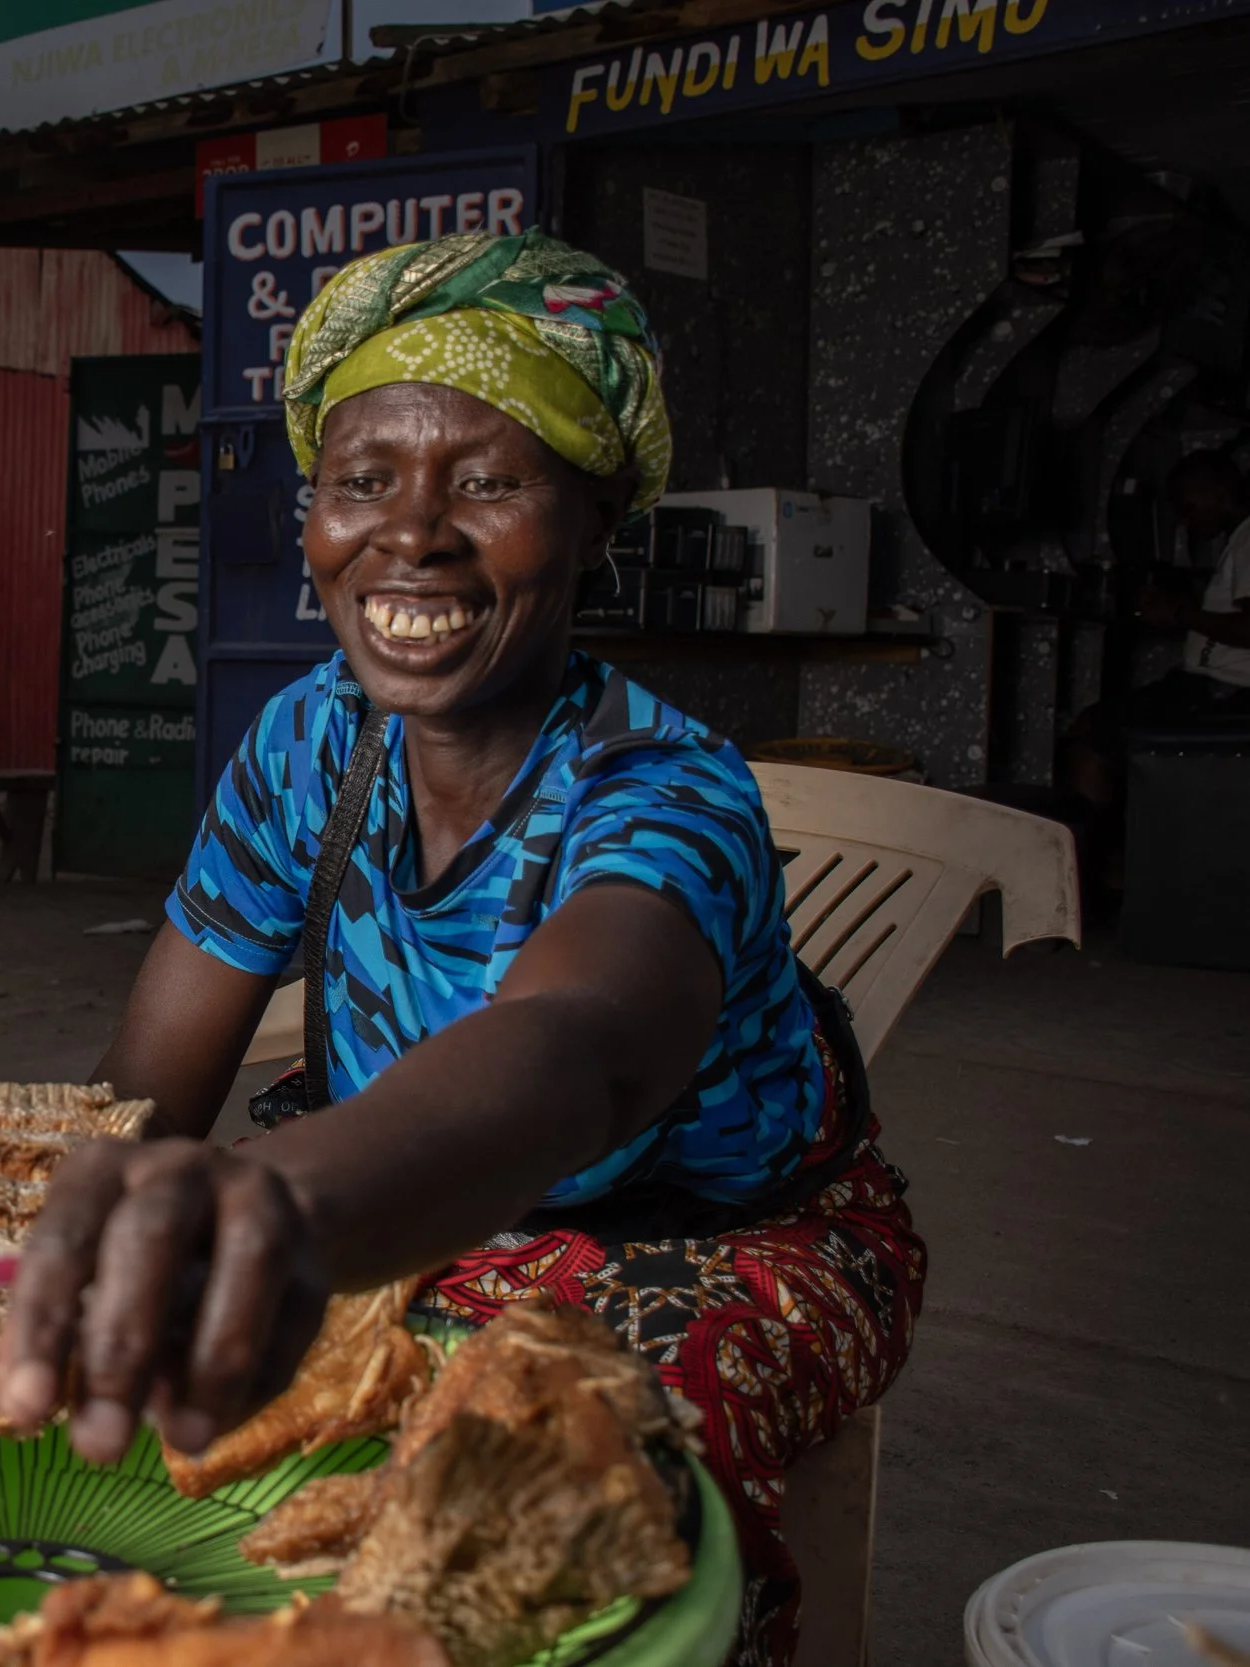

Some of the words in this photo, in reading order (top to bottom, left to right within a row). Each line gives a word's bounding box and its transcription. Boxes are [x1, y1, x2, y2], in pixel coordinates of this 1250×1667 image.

[565, 35, 741, 134] FUNDI
[754, 13, 831, 88] WA
[855, 0, 1047, 61] SIMU
[227, 187, 524, 262] COMPUTER
[247, 271, 296, 320] &
[81, 464, 152, 509] Phones
[70, 710, 130, 739] Phone
[70, 740, 130, 769] repair
